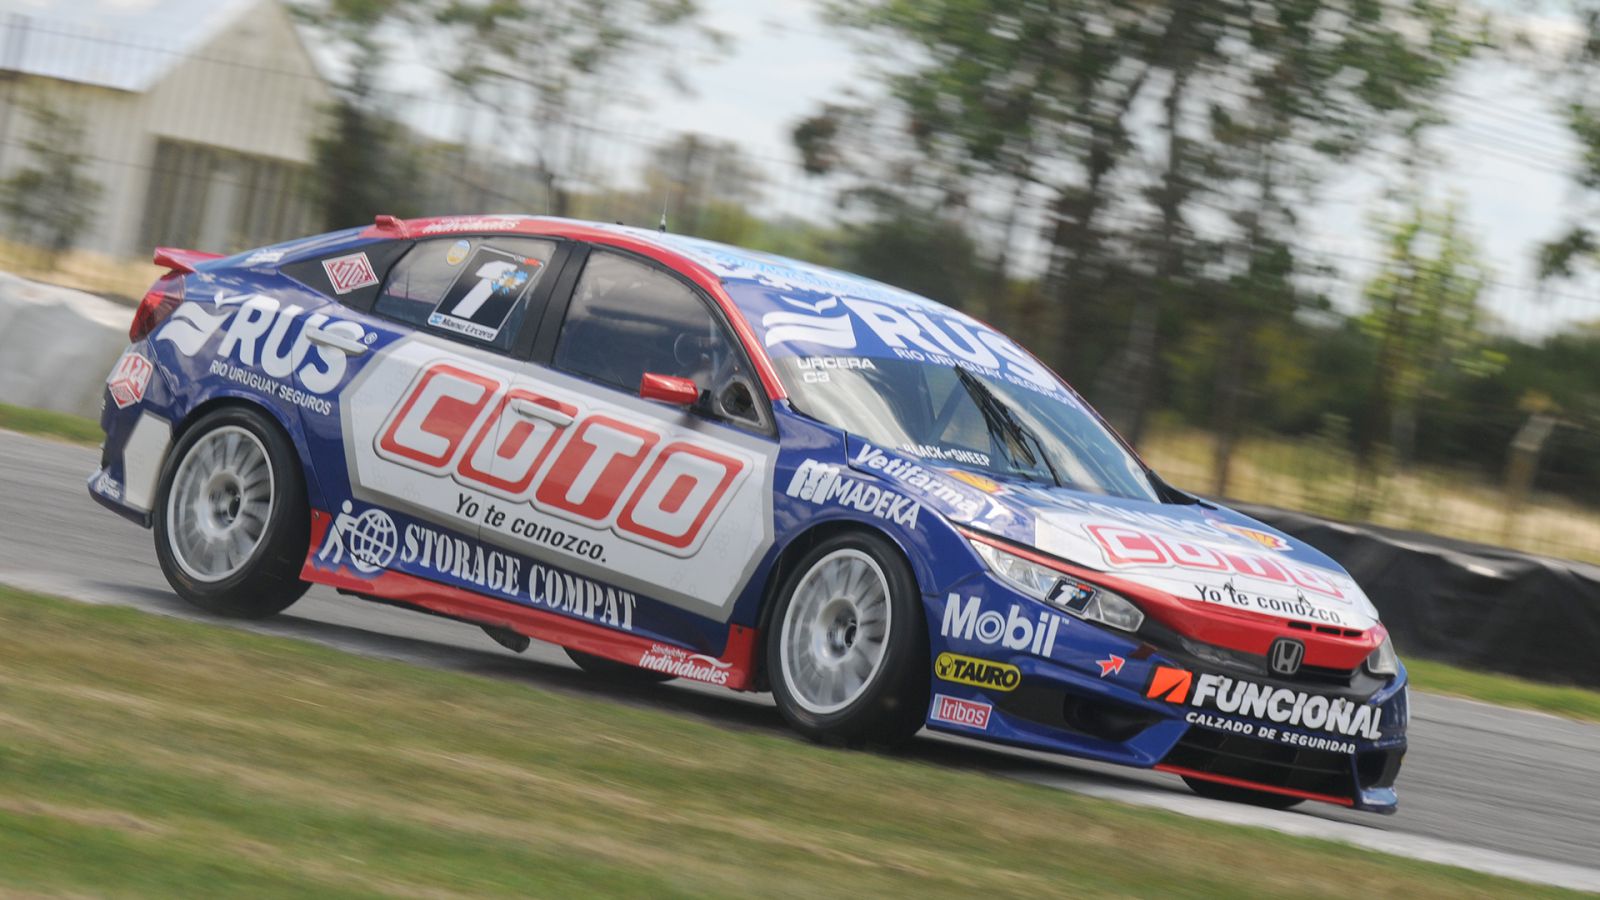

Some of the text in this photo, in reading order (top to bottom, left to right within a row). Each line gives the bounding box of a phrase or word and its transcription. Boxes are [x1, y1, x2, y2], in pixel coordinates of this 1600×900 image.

[796, 356, 877, 370] URCERA
[841, 296, 1057, 391] RUS
[209, 359, 333, 417] RIO URUGUAY SEGUROS
[803, 371, 830, 383] C3
[383, 366, 740, 546] COTO
[856, 443, 978, 515] Vetifarma
[951, 448, 991, 467] SHEEP
[825, 475, 921, 530] MADEKA
[455, 492, 608, 563] Yo te conozco.
[400, 523, 637, 631] STORAGE COMPAT
[1194, 584, 1222, 603] Yo
[1256, 595, 1349, 626] conozco.
[638, 650, 730, 685] individuales
[953, 659, 1019, 688] TAURO
[942, 697, 986, 725] tribos
[1192, 673, 1383, 741] FUNCIONAL
[1185, 711, 1254, 735] CALZADO
[1258, 727, 1276, 740] DE
[1280, 731, 1357, 754] SEGURIDAD
